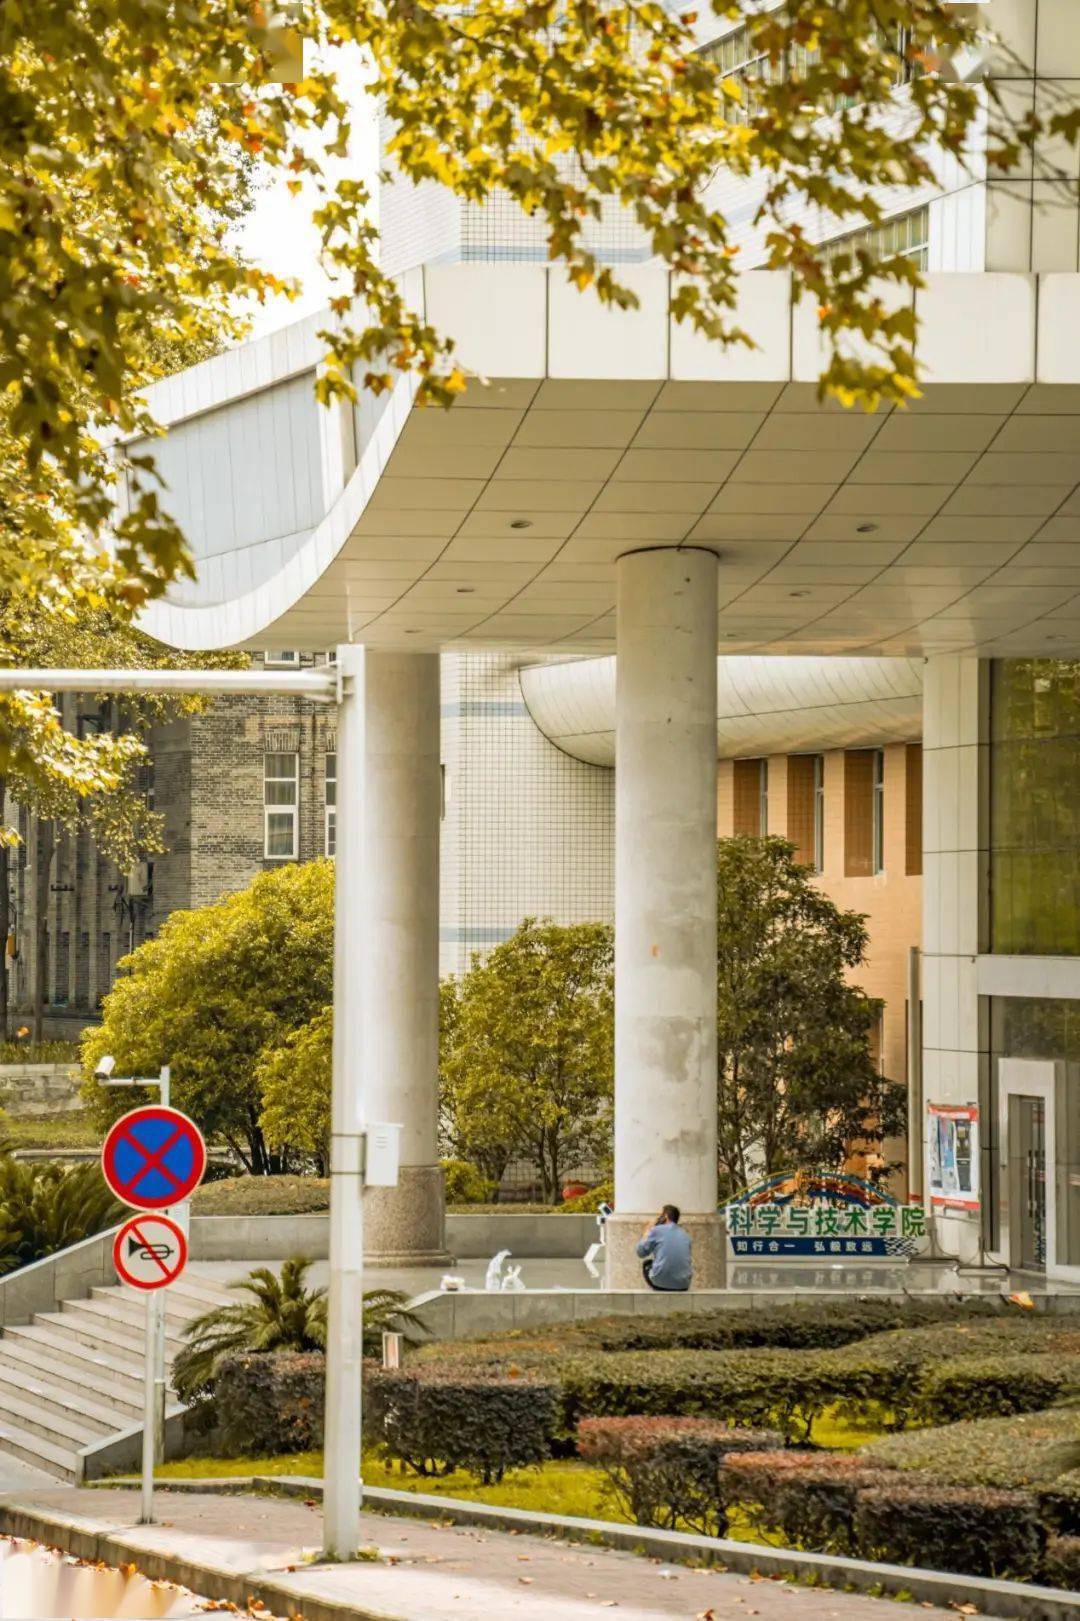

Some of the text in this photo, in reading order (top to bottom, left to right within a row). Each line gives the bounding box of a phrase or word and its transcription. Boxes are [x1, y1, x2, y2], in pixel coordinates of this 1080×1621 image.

[728, 1206, 926, 1236] 科学与技术学院
[736, 1240, 796, 1252] 知行合一
